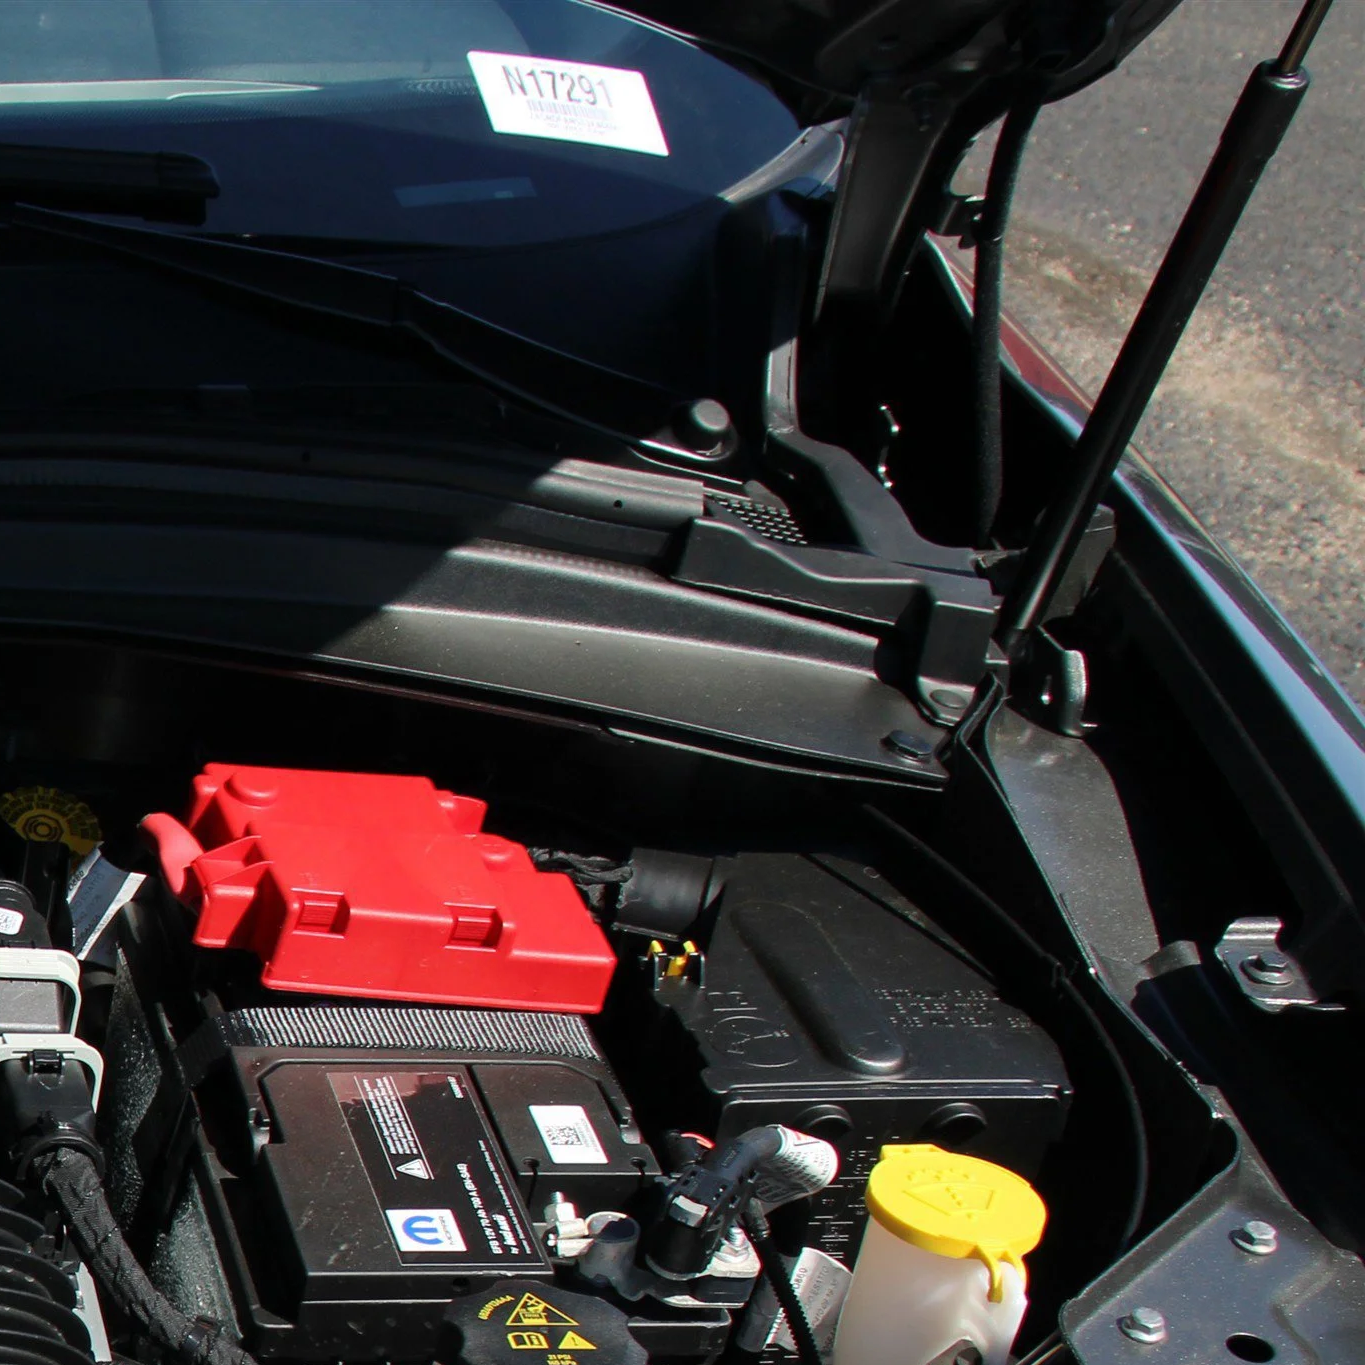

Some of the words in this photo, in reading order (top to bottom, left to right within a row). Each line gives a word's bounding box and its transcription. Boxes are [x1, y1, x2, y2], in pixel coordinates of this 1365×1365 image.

[502, 64, 613, 109] N17291
[469, 1196, 484, 1208] 700
[475, 1209, 488, 1217] Ah
[479, 1218, 491, 1226] 70
[482, 1227, 497, 1239] 12V
[488, 1240, 502, 1253] EFB
